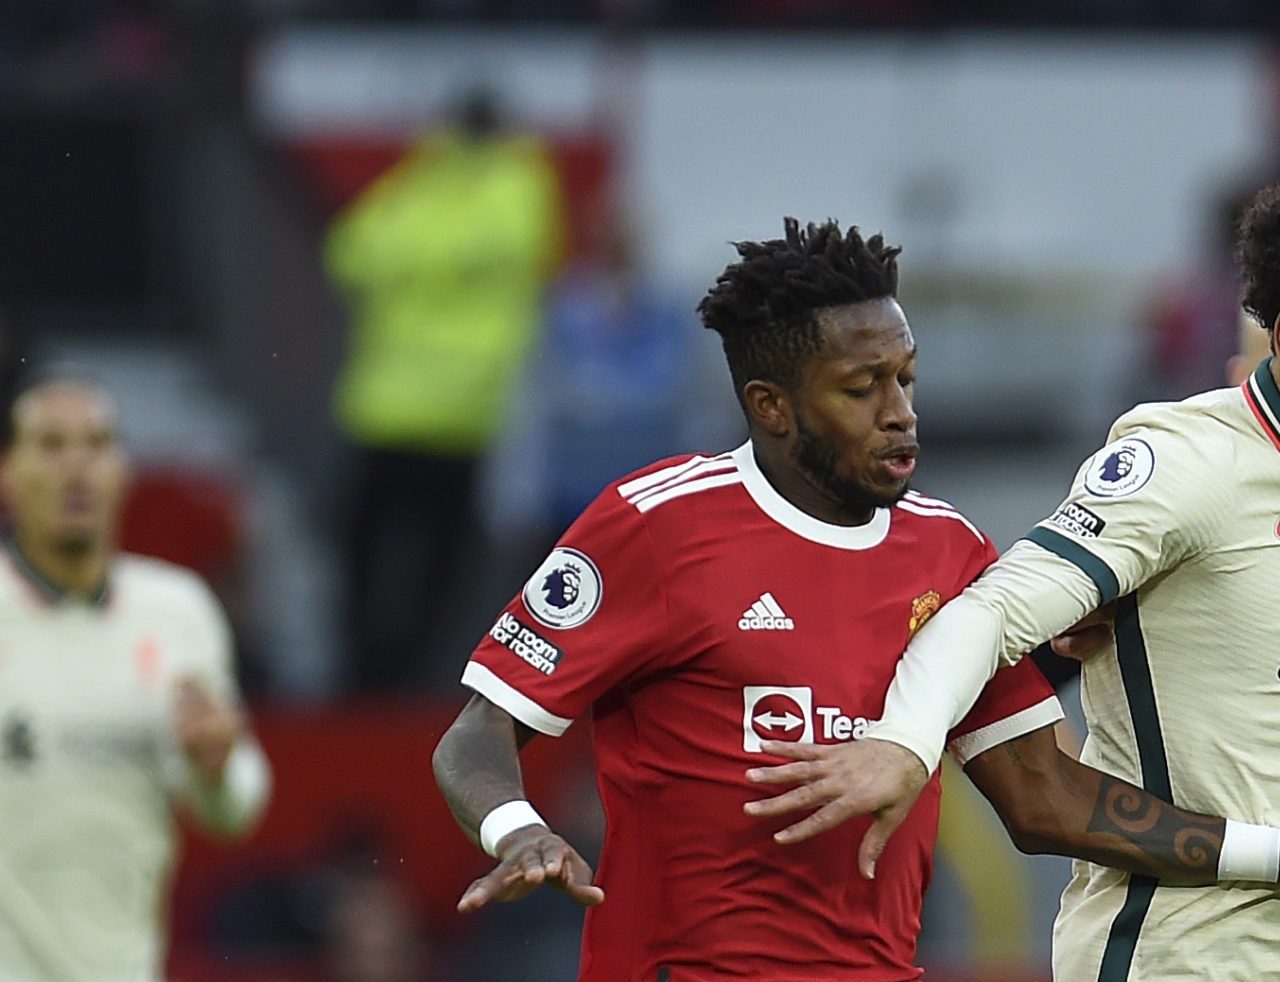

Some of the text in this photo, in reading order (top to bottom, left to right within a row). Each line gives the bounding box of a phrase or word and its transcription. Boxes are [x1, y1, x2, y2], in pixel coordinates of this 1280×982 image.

[498, 611, 559, 662] No room
[738, 615, 795, 631] adidas
[508, 638, 556, 676] racism
[816, 707, 873, 740] Tea
